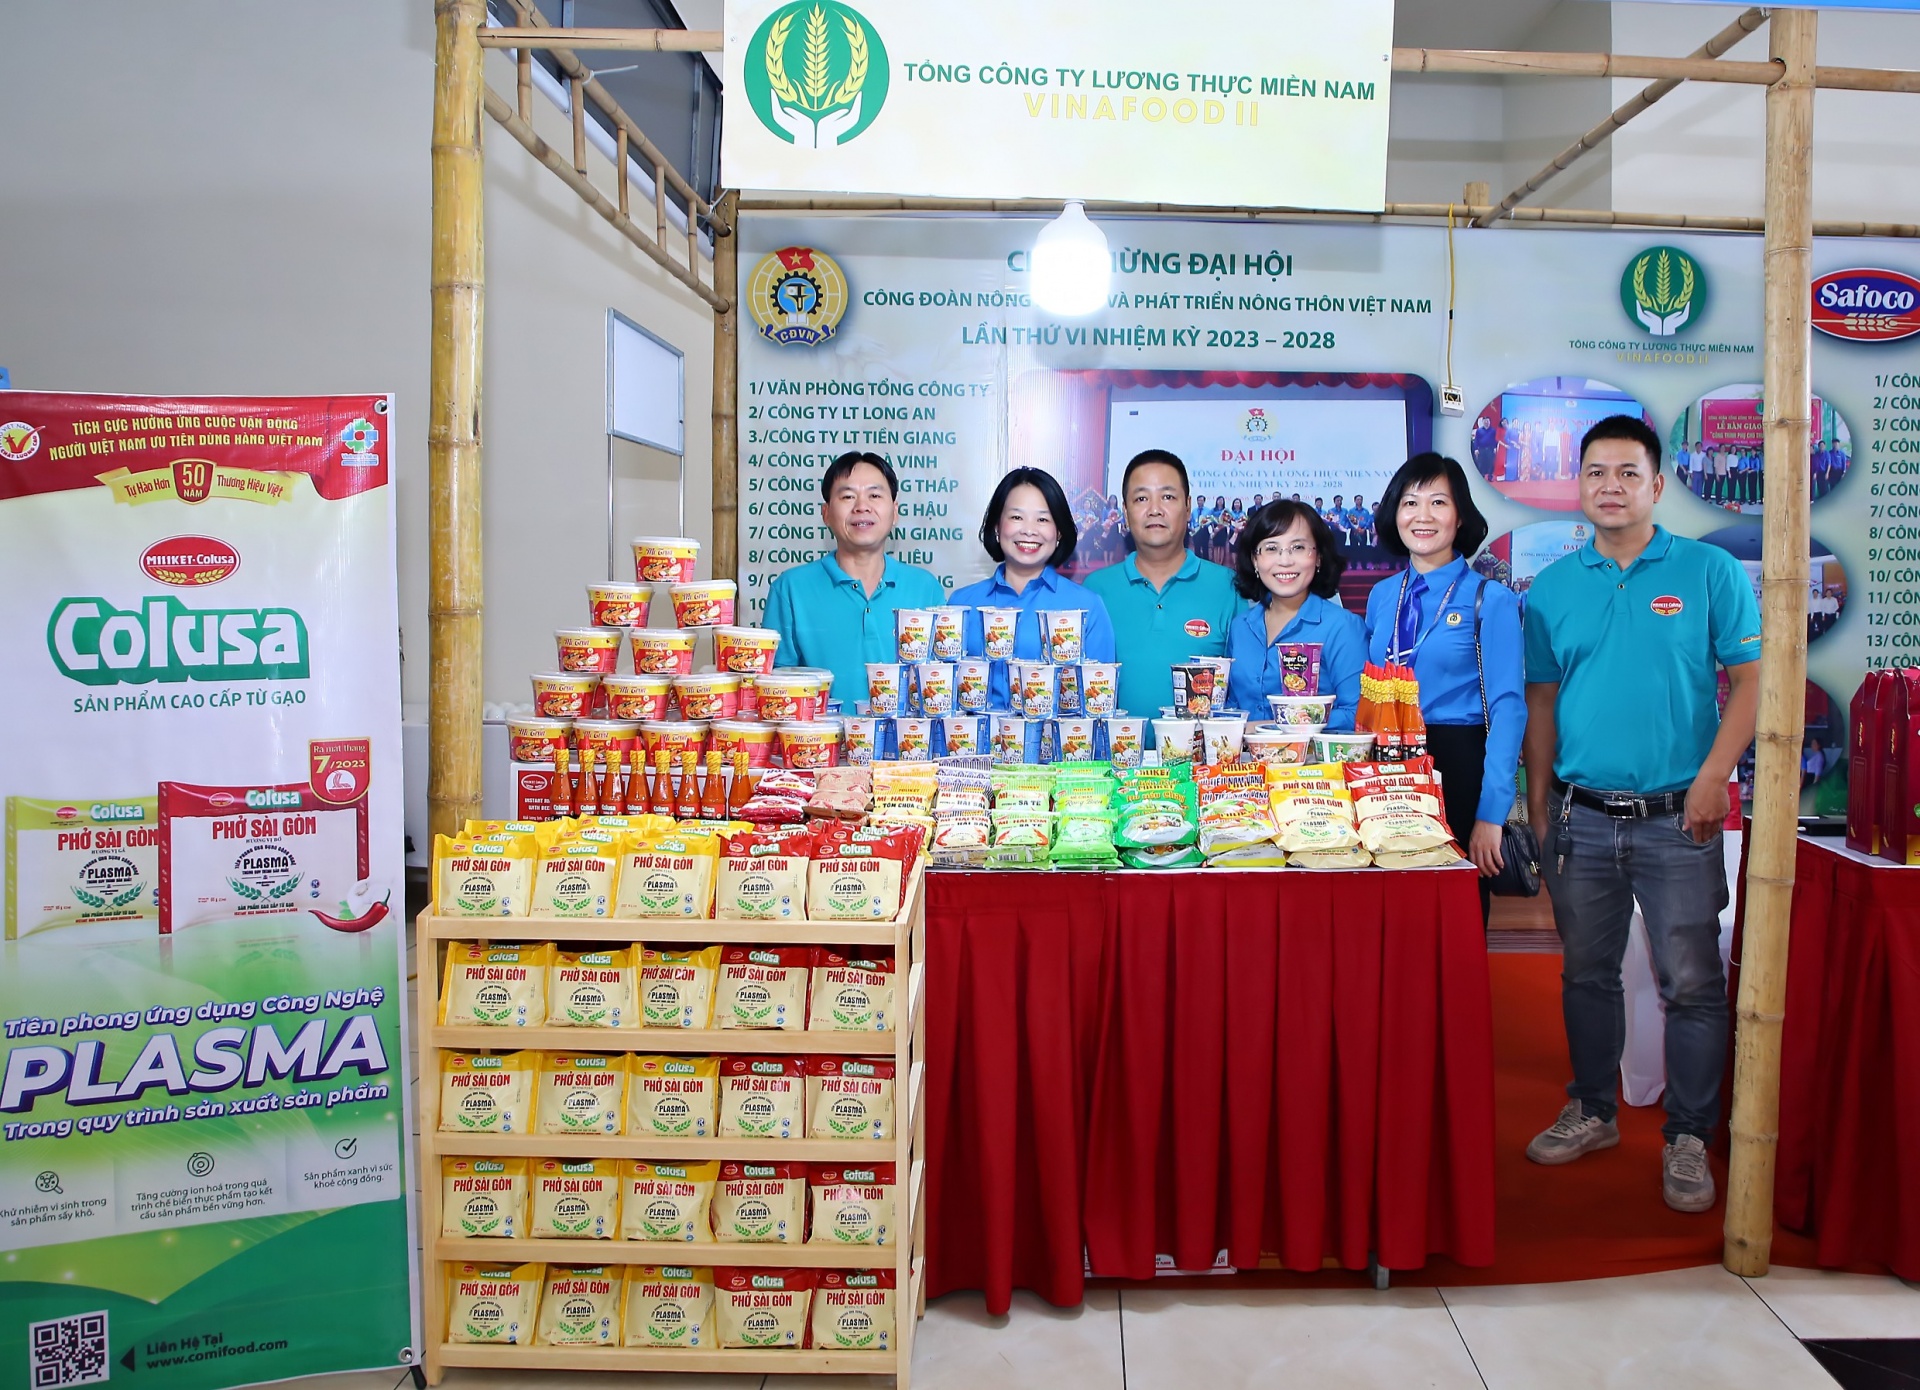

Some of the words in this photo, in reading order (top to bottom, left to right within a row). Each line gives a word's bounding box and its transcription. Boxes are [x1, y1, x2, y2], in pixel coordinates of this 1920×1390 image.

[903, 59, 971, 83] TỔNG
[979, 61, 1048, 86] CÔNG
[1055, 68, 1085, 88] TY
[1092, 70, 1179, 91] LƯƠNG
[1187, 73, 1252, 98] THỰC
[1260, 74, 1316, 97] MIỀN
[1324, 80, 1375, 100] NAM
[1023, 92, 1225, 124] VINAFOOD
[1236, 101, 1258, 126] II
[1111, 247, 1180, 274] ỪNG
[1188, 252, 1235, 282] ĐẠI
[1244, 250, 1292, 282] HỘI
[863, 288, 915, 307] CÔNG
[919, 288, 972, 307] ĐOÀN
[978, 289, 1031, 307] NÔNG
[1107, 291, 1130, 308] VÀ
[1134, 292, 1180, 309] PHÁT
[1184, 290, 1233, 310] TRIỂN
[1239, 293, 1291, 311] NÔNG
[1296, 294, 1345, 312] THÔN
[1349, 295, 1387, 316] VIỆT
[1391, 298, 1431, 313] NAM
[1820, 282, 1914, 310] Safoco
[780, 329, 815, 341] CĐVN
[962, 321, 1006, 345] LẦN
[1012, 324, 1062, 345] THỨ
[1065, 327, 1086, 345] VI
[1093, 324, 1166, 350] NHIỆM
[1172, 325, 1200, 347] KỲ
[1207, 330, 1259, 348] 2023
[1282, 331, 1335, 349] 2028
[1629, 342, 1640, 350] TY
[1616, 353, 1695, 364] VINAFOOD
[767, 379, 801, 396] VĂN
[805, 378, 864, 396] PHÒNG
[868, 378, 914, 397] TỔNG
[918, 379, 965, 397] CÔNG
[968, 384, 990, 398] TY
[767, 402, 815, 420] CÔNG
[818, 406, 838, 420] TY
[842, 406, 860, 420] LT
[863, 406, 908, 420] LONG
[912, 407, 936, 420] AN
[72, 420, 100, 435] TÍCH
[104, 418, 128, 434] CỰC
[132, 414, 172, 430] HƯỞNG
[177, 414, 200, 428] ỨNG
[205, 415, 236, 430] CUỘC
[240, 416, 262, 430] VẬN
[267, 416, 298, 430] ĐỘNG
[819, 430, 839, 444] TY
[843, 430, 860, 444] LT
[863, 426, 899, 444] TIỀN
[903, 430, 957, 445] GIANG
[49, 442, 86, 460] NGƯỜI
[90, 438, 114, 456] VIỆT
[119, 437, 146, 451] NAM
[150, 436, 166, 448] ƯU
[170, 433, 194, 446] TIÊN
[200, 433, 230, 445] DÙNG
[235, 432, 264, 445] HÀNG
[269, 433, 292, 447] VIỆT
[296, 435, 323, 446] NAM
[1221, 448, 1255, 464] ĐẠI
[1261, 447, 1295, 464] HỘI
[897, 454, 938, 469] VINH
[182, 464, 205, 487] 50
[915, 474, 959, 493] THÁP
[138, 481, 153, 494] Hào
[217, 475, 245, 490] Thương
[247, 478, 265, 493] Hiệu
[267, 482, 283, 497] Việt
[912, 501, 948, 521] HẬU
[910, 526, 963, 541] GIANG
[899, 545, 933, 564] LIÊU
[52, 600, 302, 672] Colusa
[74, 693, 109, 712] SẢN
[114, 690, 166, 711] PHẨM
[171, 694, 205, 708] CAO
[209, 688, 242, 706] CẤP
[246, 688, 268, 706] TỪ
[271, 689, 306, 706] GẠO
[473, 844, 505, 854] Colusa
[452, 857, 470, 872] PHỞ
[472, 858, 488, 872] SÀI
[490, 857, 511, 872] GÒN
[464, 884, 491, 892] PLASMA
[5, 1017, 57, 1038] Tiên
[61, 1012, 139, 1036] phong
[145, 1005, 192, 1026] ứng
[196, 1000, 256, 1022] dụng
[262, 995, 320, 1014] Công
[325, 986, 384, 1009] Nghệ
[0, 1014, 388, 1113] PLASMA
[5, 1118, 73, 1140] Trong
[77, 1114, 122, 1136] quy
[125, 1104, 179, 1126] trình
[184, 1099, 224, 1119] sản
[229, 1092, 279, 1114] xuất
[283, 1089, 321, 1108] sản
[326, 1082, 388, 1108] phẩm
[752, 1275, 784, 1288] Colusa
[732, 1292, 752, 1307] PHỞ
[754, 1293, 769, 1307] SÀI
[772, 1294, 792, 1307] GÒN
[748, 1319, 775, 1327] PLASMA
[146, 1341, 178, 1356] Liên
[180, 1336, 200, 1351] Hệ
[202, 1332, 223, 1348] Tại
[146, 1339, 288, 1369] www.comifood.com
